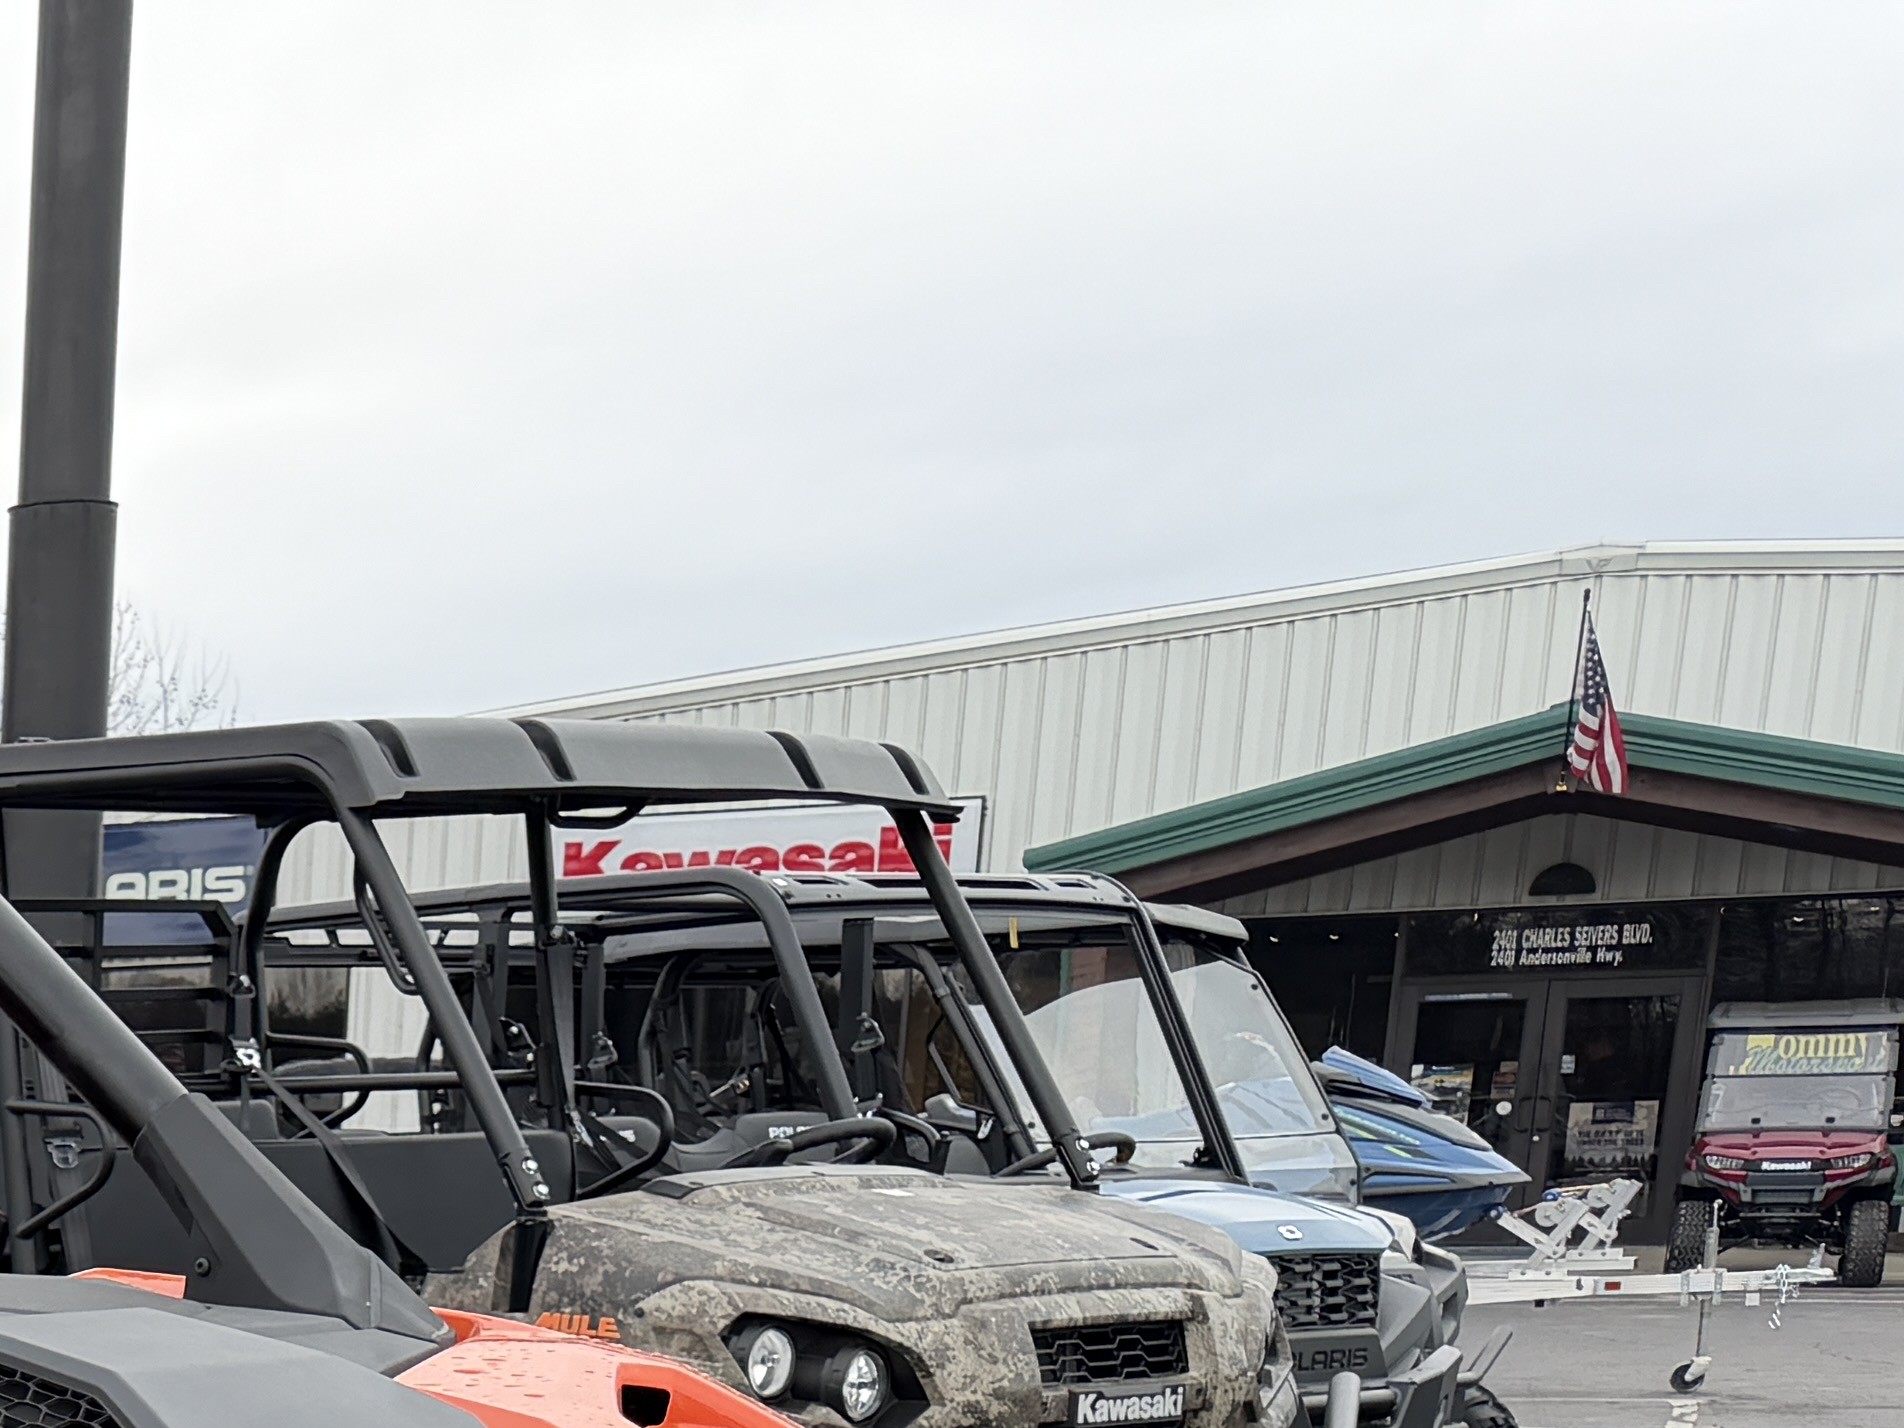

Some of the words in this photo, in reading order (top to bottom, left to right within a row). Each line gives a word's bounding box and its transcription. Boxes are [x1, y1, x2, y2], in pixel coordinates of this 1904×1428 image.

[105, 866, 247, 903] ARIS
[1492, 930, 1517, 949] 2401
[1522, 927, 1571, 948] CHARLES
[535, 1312, 621, 1339] MULE
[1078, 1387, 1184, 1424] Kawasaki
